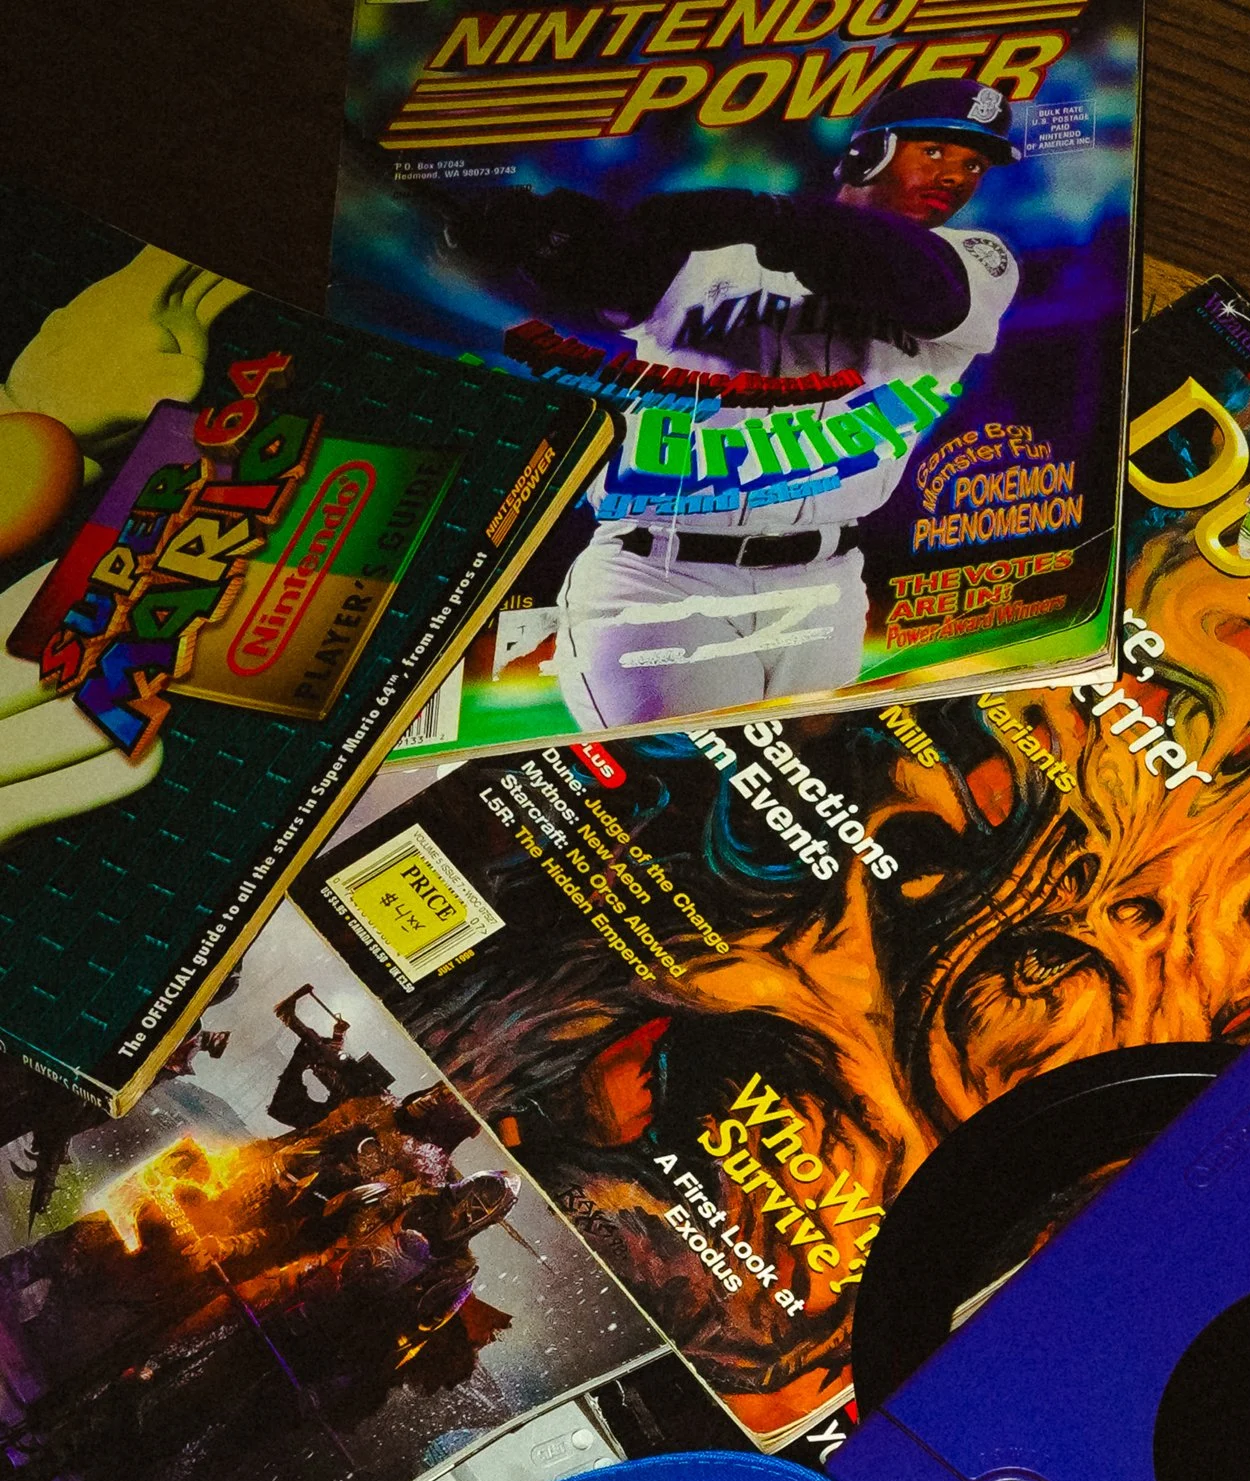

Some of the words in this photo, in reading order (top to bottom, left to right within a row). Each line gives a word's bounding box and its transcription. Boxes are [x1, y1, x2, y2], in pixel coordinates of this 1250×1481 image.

[427, 0, 912, 70] NINTENDO
[608, 30, 1069, 137] POWER
[1039, 130, 1081, 142] NINTENDO
[1050, 123, 1070, 132] PAID
[193, 350, 293, 447] 64
[632, 400, 910, 480] Griffey
[887, 373, 965, 433] Jr.
[485, 464, 534, 540] NINTENDO
[512, 446, 558, 515] POWER
[912, 494, 1085, 552] PHENOMENON
[40, 460, 208, 688] SUPER
[74, 411, 320, 760] MARIO
[242, 480, 362, 658] Nintendo
[885, 594, 960, 626] ARE
[889, 568, 963, 599] THE
[962, 550, 1075, 588] VOTES
[878, 703, 942, 770] Mills
[118, 1031, 147, 1059] The
[141, 966, 198, 1030] OFFICIAL
[191, 919, 228, 967] guide
[251, 853, 277, 889] the
[272, 815, 305, 855] stars
[310, 750, 349, 798] Super
[341, 706, 382, 758] Mario
[426, 604, 453, 637] the
[519, 758, 581, 827] Mythos:
[575, 822, 614, 863] New
[609, 860, 655, 906] Aeon
[727, 761, 842, 883] Events
[742, 719, 901, 883] Sanctions
[400, 864, 458, 923] PRICE
[412, 830, 440, 864] VOLUME
[440, 863, 462, 886] ISSUE
[477, 786, 519, 830] L5R:
[513, 824, 544, 862] The
[539, 857, 595, 918] Hidden
[589, 911, 659, 985] Emperor
[499, 772, 571, 852] Starcraft:
[587, 871, 628, 918] Orcs
[622, 913, 689, 982] Allowed
[541, 746, 588, 798] Dune:
[583, 794, 632, 848] Judge
[645, 862, 674, 894] the
[671, 891, 732, 957] Change
[347, 917, 372, 948] CANADA
[437, 961, 458, 978] JULY
[729, 1071, 824, 1183] Who
[663, 1203, 744, 1295] Exodus
[672, 1170, 730, 1229] First
[720, 1224, 780, 1289] Look
[773, 1286, 808, 1318] at
